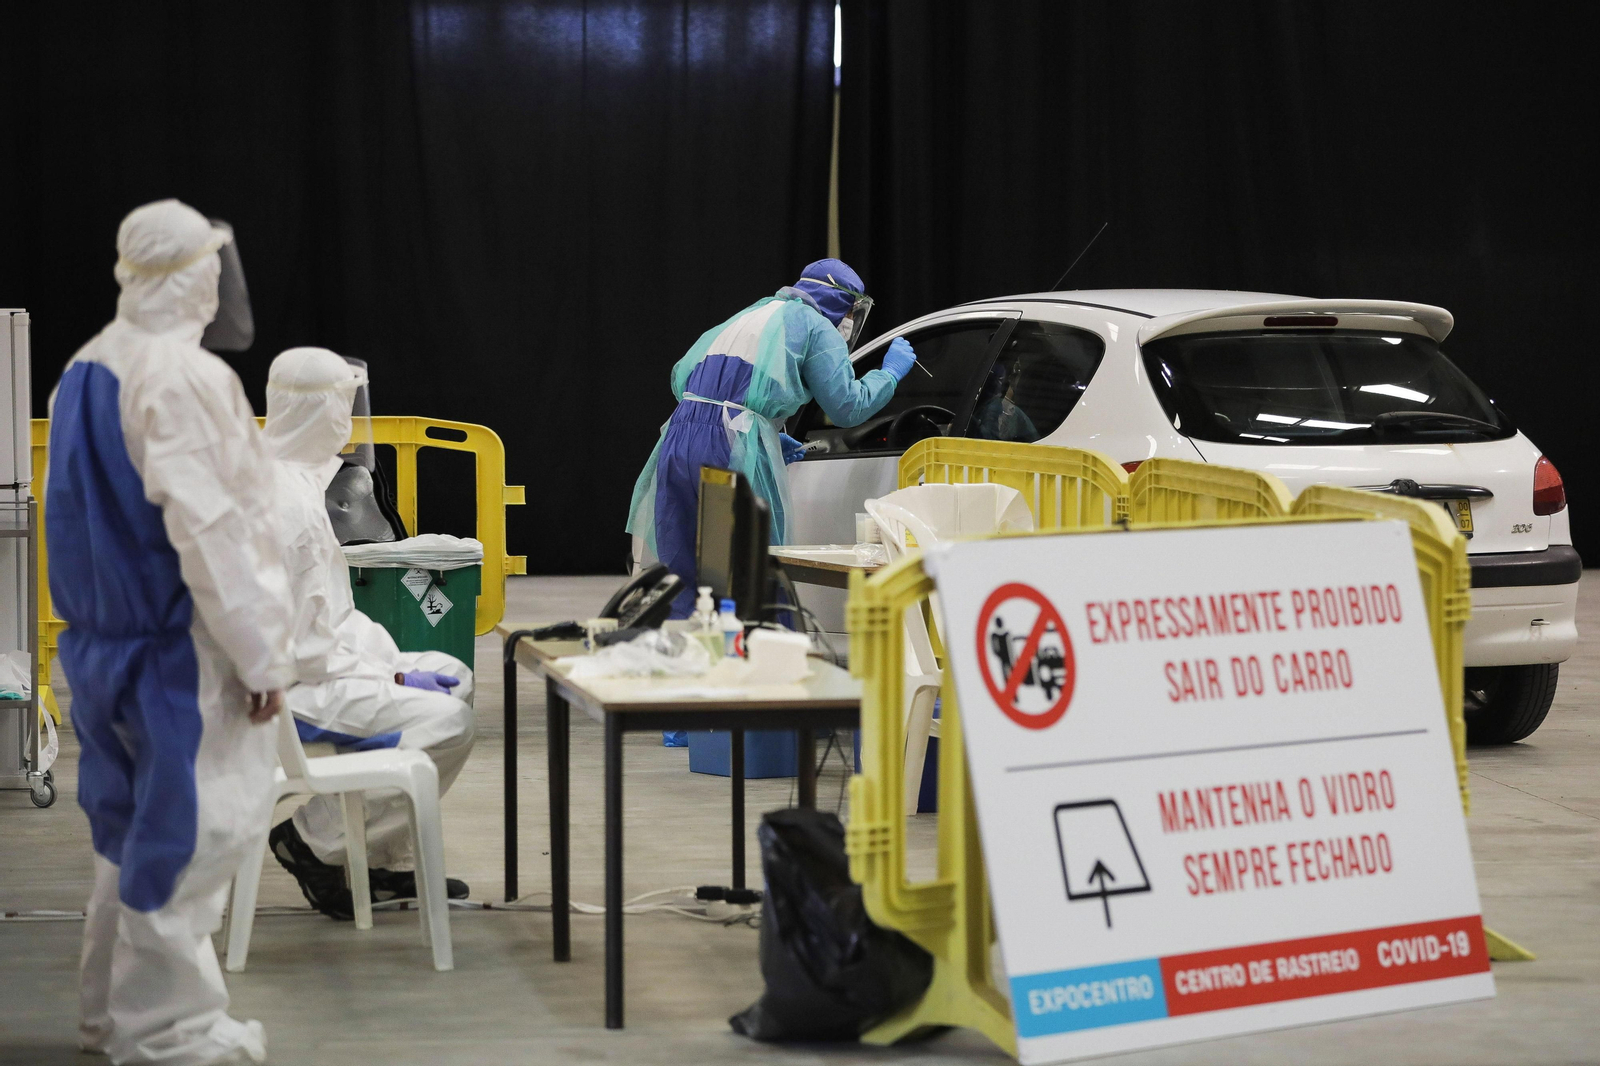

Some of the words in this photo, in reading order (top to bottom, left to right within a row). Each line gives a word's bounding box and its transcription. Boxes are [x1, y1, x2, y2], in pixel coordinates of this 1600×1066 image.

[1458, 502, 1469, 511] 00
[1460, 519, 1470, 528] 07
[1085, 589, 1287, 645] EXPRESSAMENTE
[1292, 583, 1402, 630] PROIBIDO
[1165, 656, 1223, 703] SAIR
[1231, 654, 1265, 698] DO
[1275, 648, 1353, 694] CARRO
[1158, 778, 1291, 833] MANTENHA
[1299, 778, 1316, 819] O
[1324, 769, 1396, 816] VIDRO
[1184, 844, 1283, 897] SEMPRE
[1286, 832, 1392, 883] FECHADO
[1175, 964, 1246, 995] CENTRO
[1250, 959, 1274, 985] DE
[1277, 949, 1360, 981] RASTREIO
[1376, 931, 1470, 968] COVID-19
[1028, 974, 1153, 1016] EXPOCENTRO
